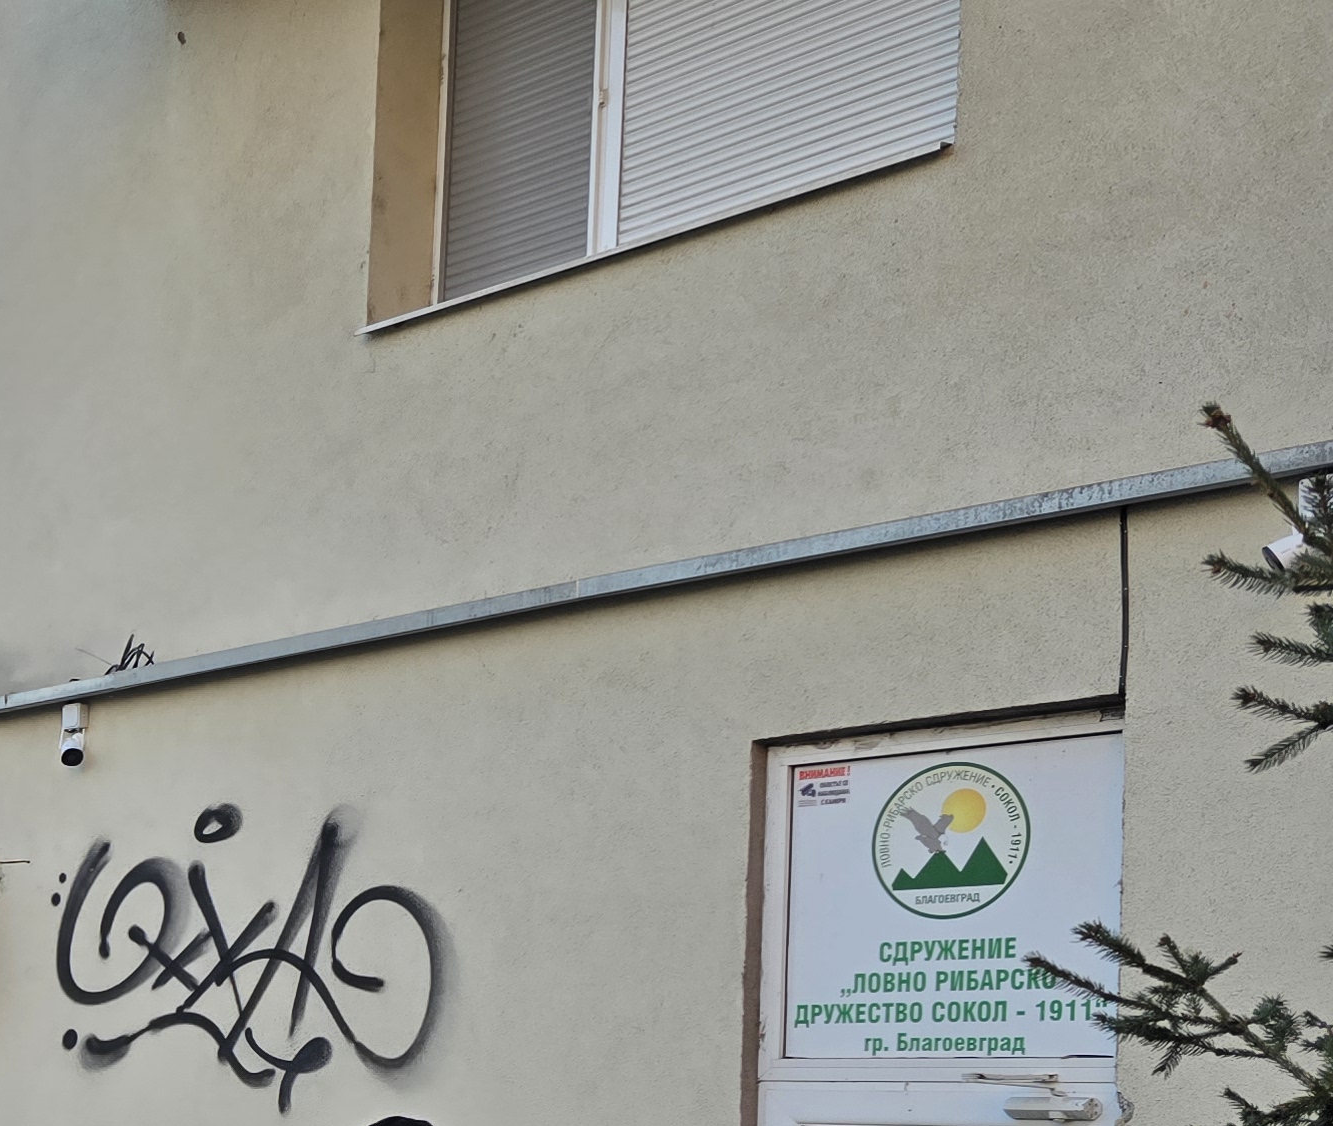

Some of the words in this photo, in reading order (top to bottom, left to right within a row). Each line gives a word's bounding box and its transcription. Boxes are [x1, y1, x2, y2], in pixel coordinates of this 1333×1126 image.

[925, 769, 991, 788] СДРУЖЕНИЕ
[994, 786, 1021, 822] СОКОЛ
[1007, 832, 1022, 859] 1911
[915, 892, 981, 905] БЛАГОЕВГРАД
[879, 937, 1017, 966] СДРУЖЕНИЕ
[794, 1002, 923, 1028] ДРУЖЕСТВО
[932, 1000, 1008, 1023] СОКОЛ
[865, 1037, 889, 1052] гр.
[897, 1033, 1026, 1055] Благоевград
